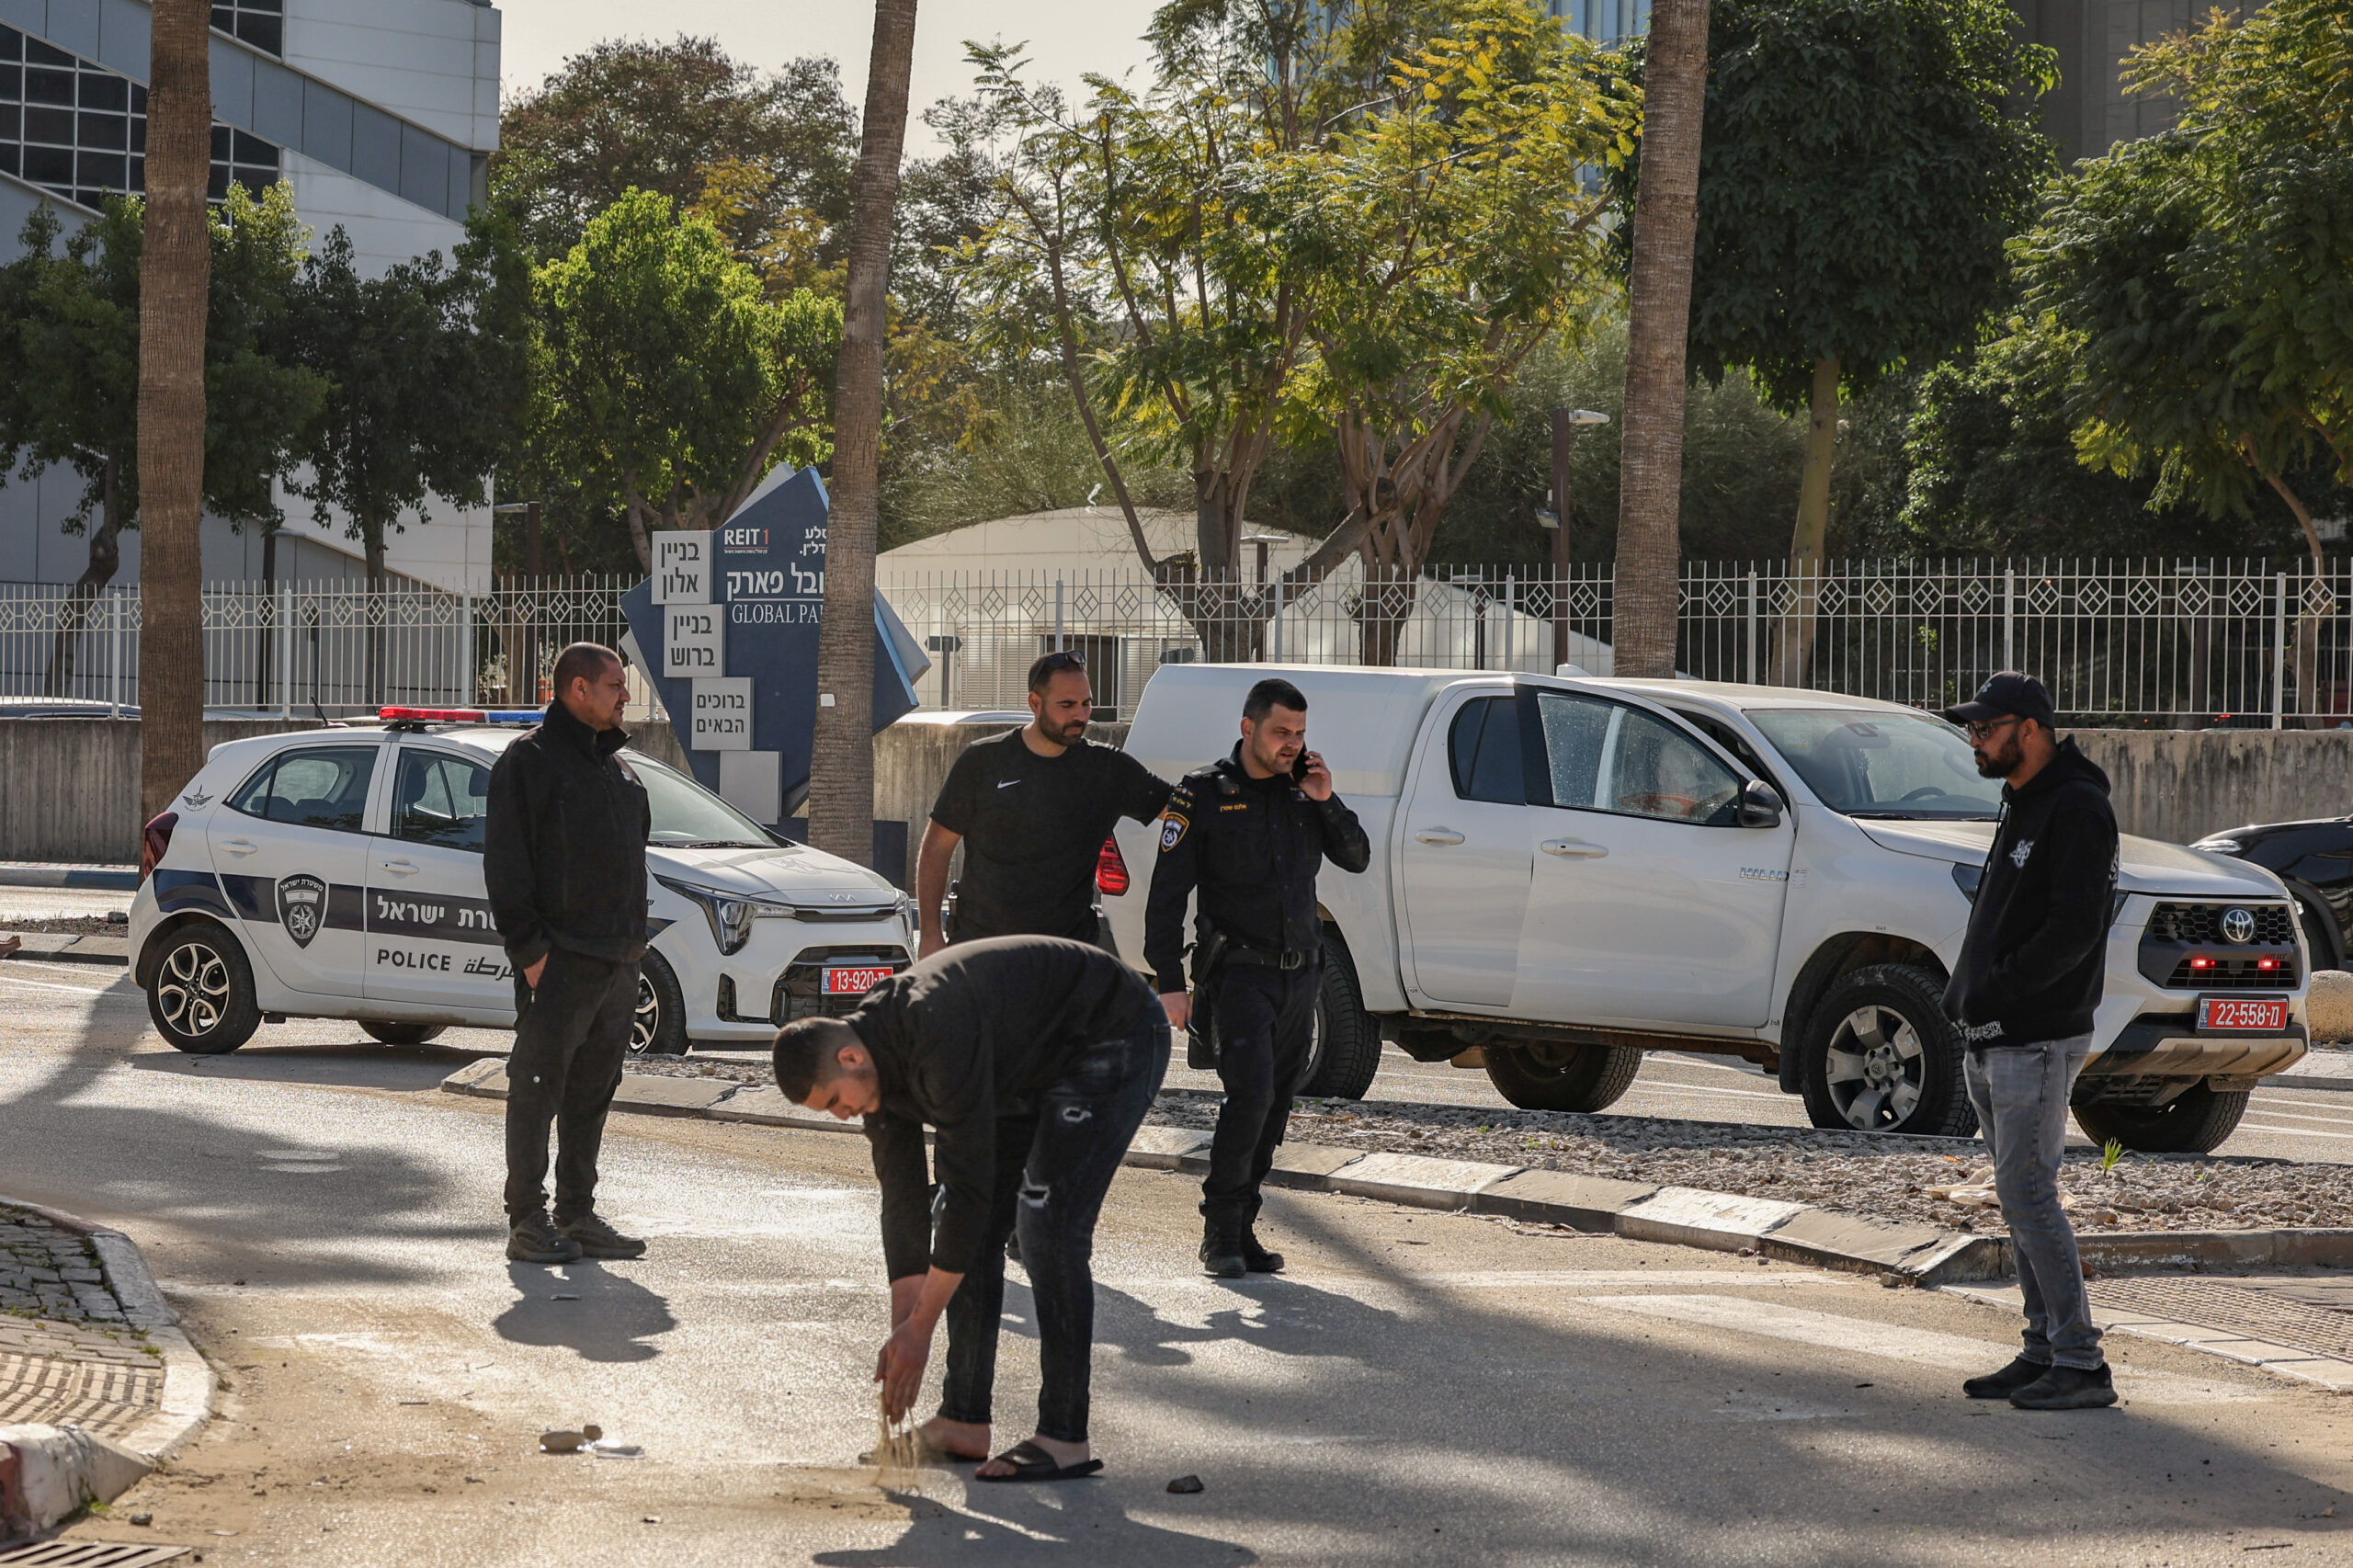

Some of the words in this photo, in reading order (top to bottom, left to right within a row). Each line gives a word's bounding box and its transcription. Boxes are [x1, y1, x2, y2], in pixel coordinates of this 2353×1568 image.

[724, 528, 760, 545] REIT
[763, 528, 769, 545] 1
[661, 542, 700, 568] בניין
[663, 567, 699, 600] אלון
[726, 571, 784, 602] פארק
[790, 562, 824, 594] ובל
[732, 604, 795, 623] GLOBAL
[799, 604, 824, 623] PA
[673, 615, 712, 641] בניין
[670, 647, 715, 666] ברוש
[697, 694, 745, 709] ברוכים
[697, 719, 745, 733] הבאים
[279, 879, 301, 892] ישראל
[377, 895, 445, 925] ישראל
[377, 949, 451, 971] POLICE
[463, 957, 515, 981] رطة
